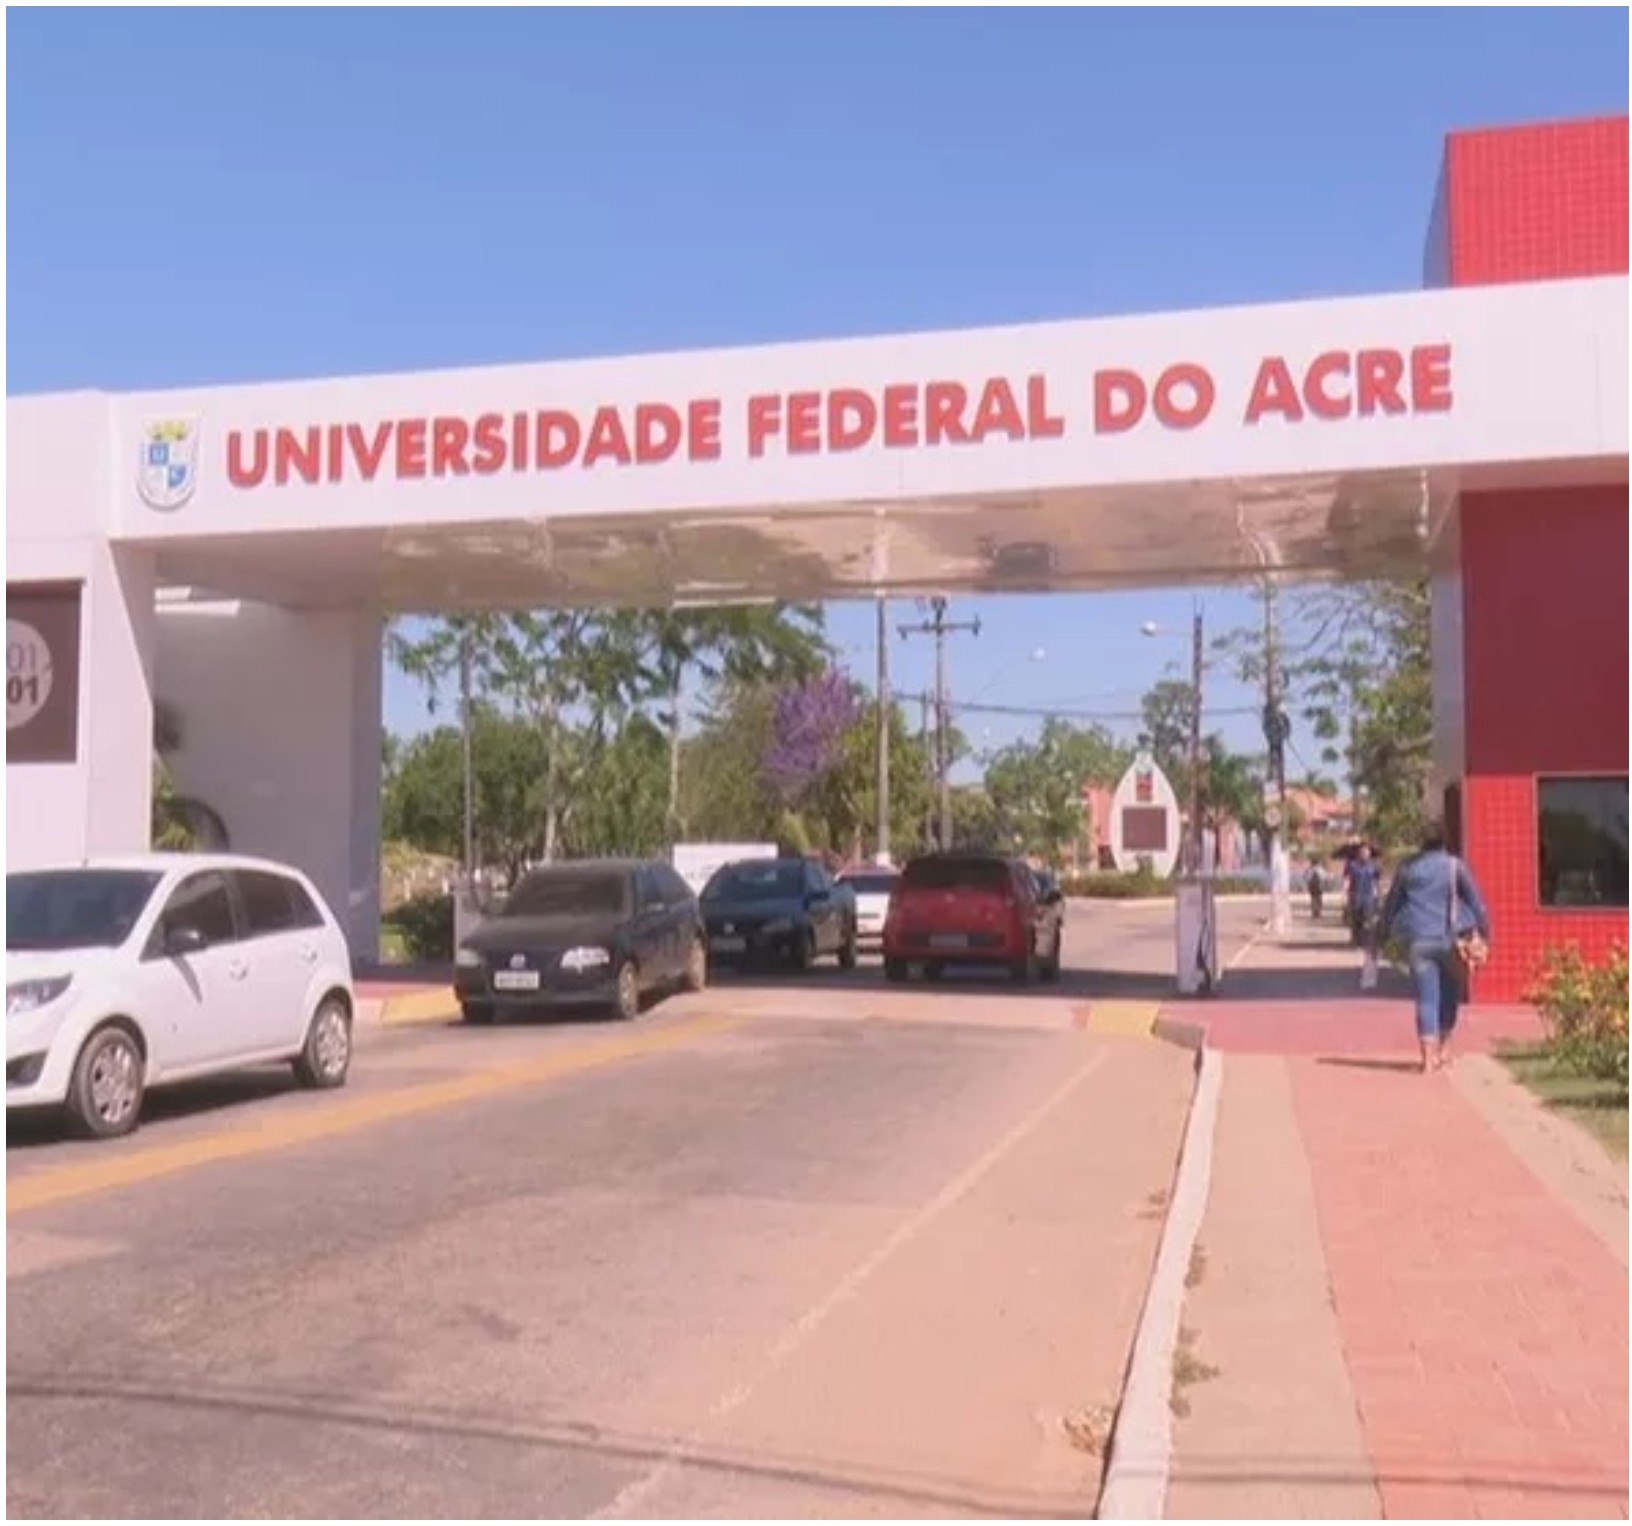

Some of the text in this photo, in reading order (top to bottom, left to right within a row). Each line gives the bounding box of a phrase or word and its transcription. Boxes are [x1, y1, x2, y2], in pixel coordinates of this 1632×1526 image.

[227, 345, 1453, 486] UNIVERSIDADE FEDERAL DO ACRE
